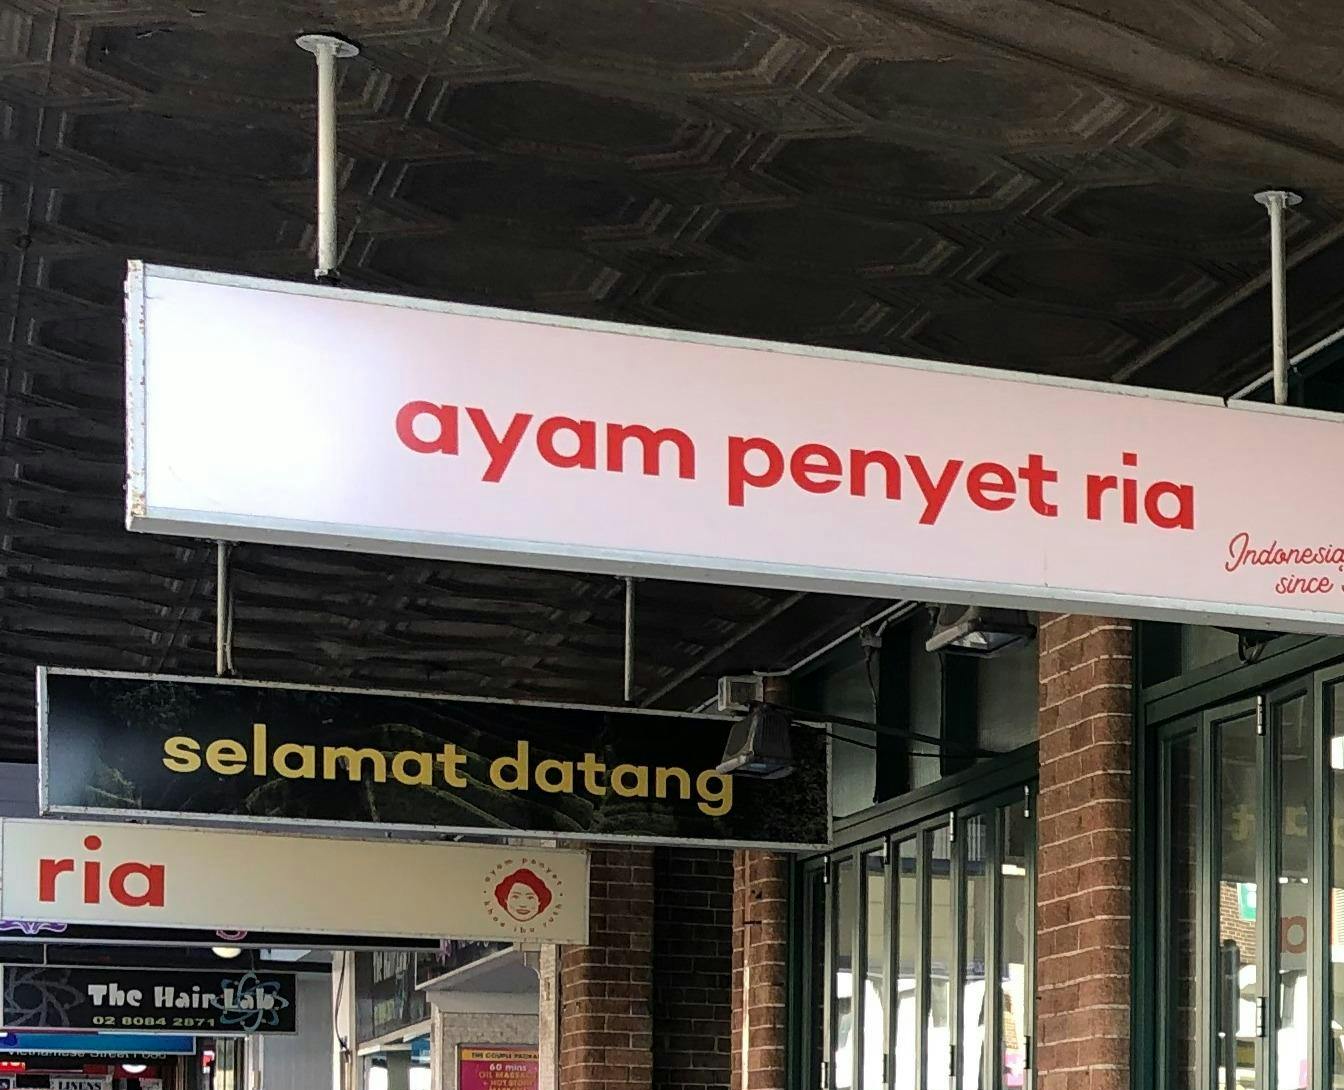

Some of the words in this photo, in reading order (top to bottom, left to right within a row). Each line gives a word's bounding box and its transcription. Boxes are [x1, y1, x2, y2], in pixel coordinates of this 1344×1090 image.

[394, 400, 696, 483] ayam
[727, 435, 1059, 526] penyet
[1086, 451, 1195, 531] ria
[1275, 574, 1334, 594] since
[162, 723, 467, 788] selamat
[489, 740, 734, 816] datang
[38, 834, 165, 907] ria
[87, 983, 143, 1008] The
[154, 985, 216, 1009] Hair
[223, 987, 275, 1010] Lab
[92, 1016, 116, 1026] 02
[122, 1016, 166, 1026] 8084
[172, 1016, 215, 1027] 2871
